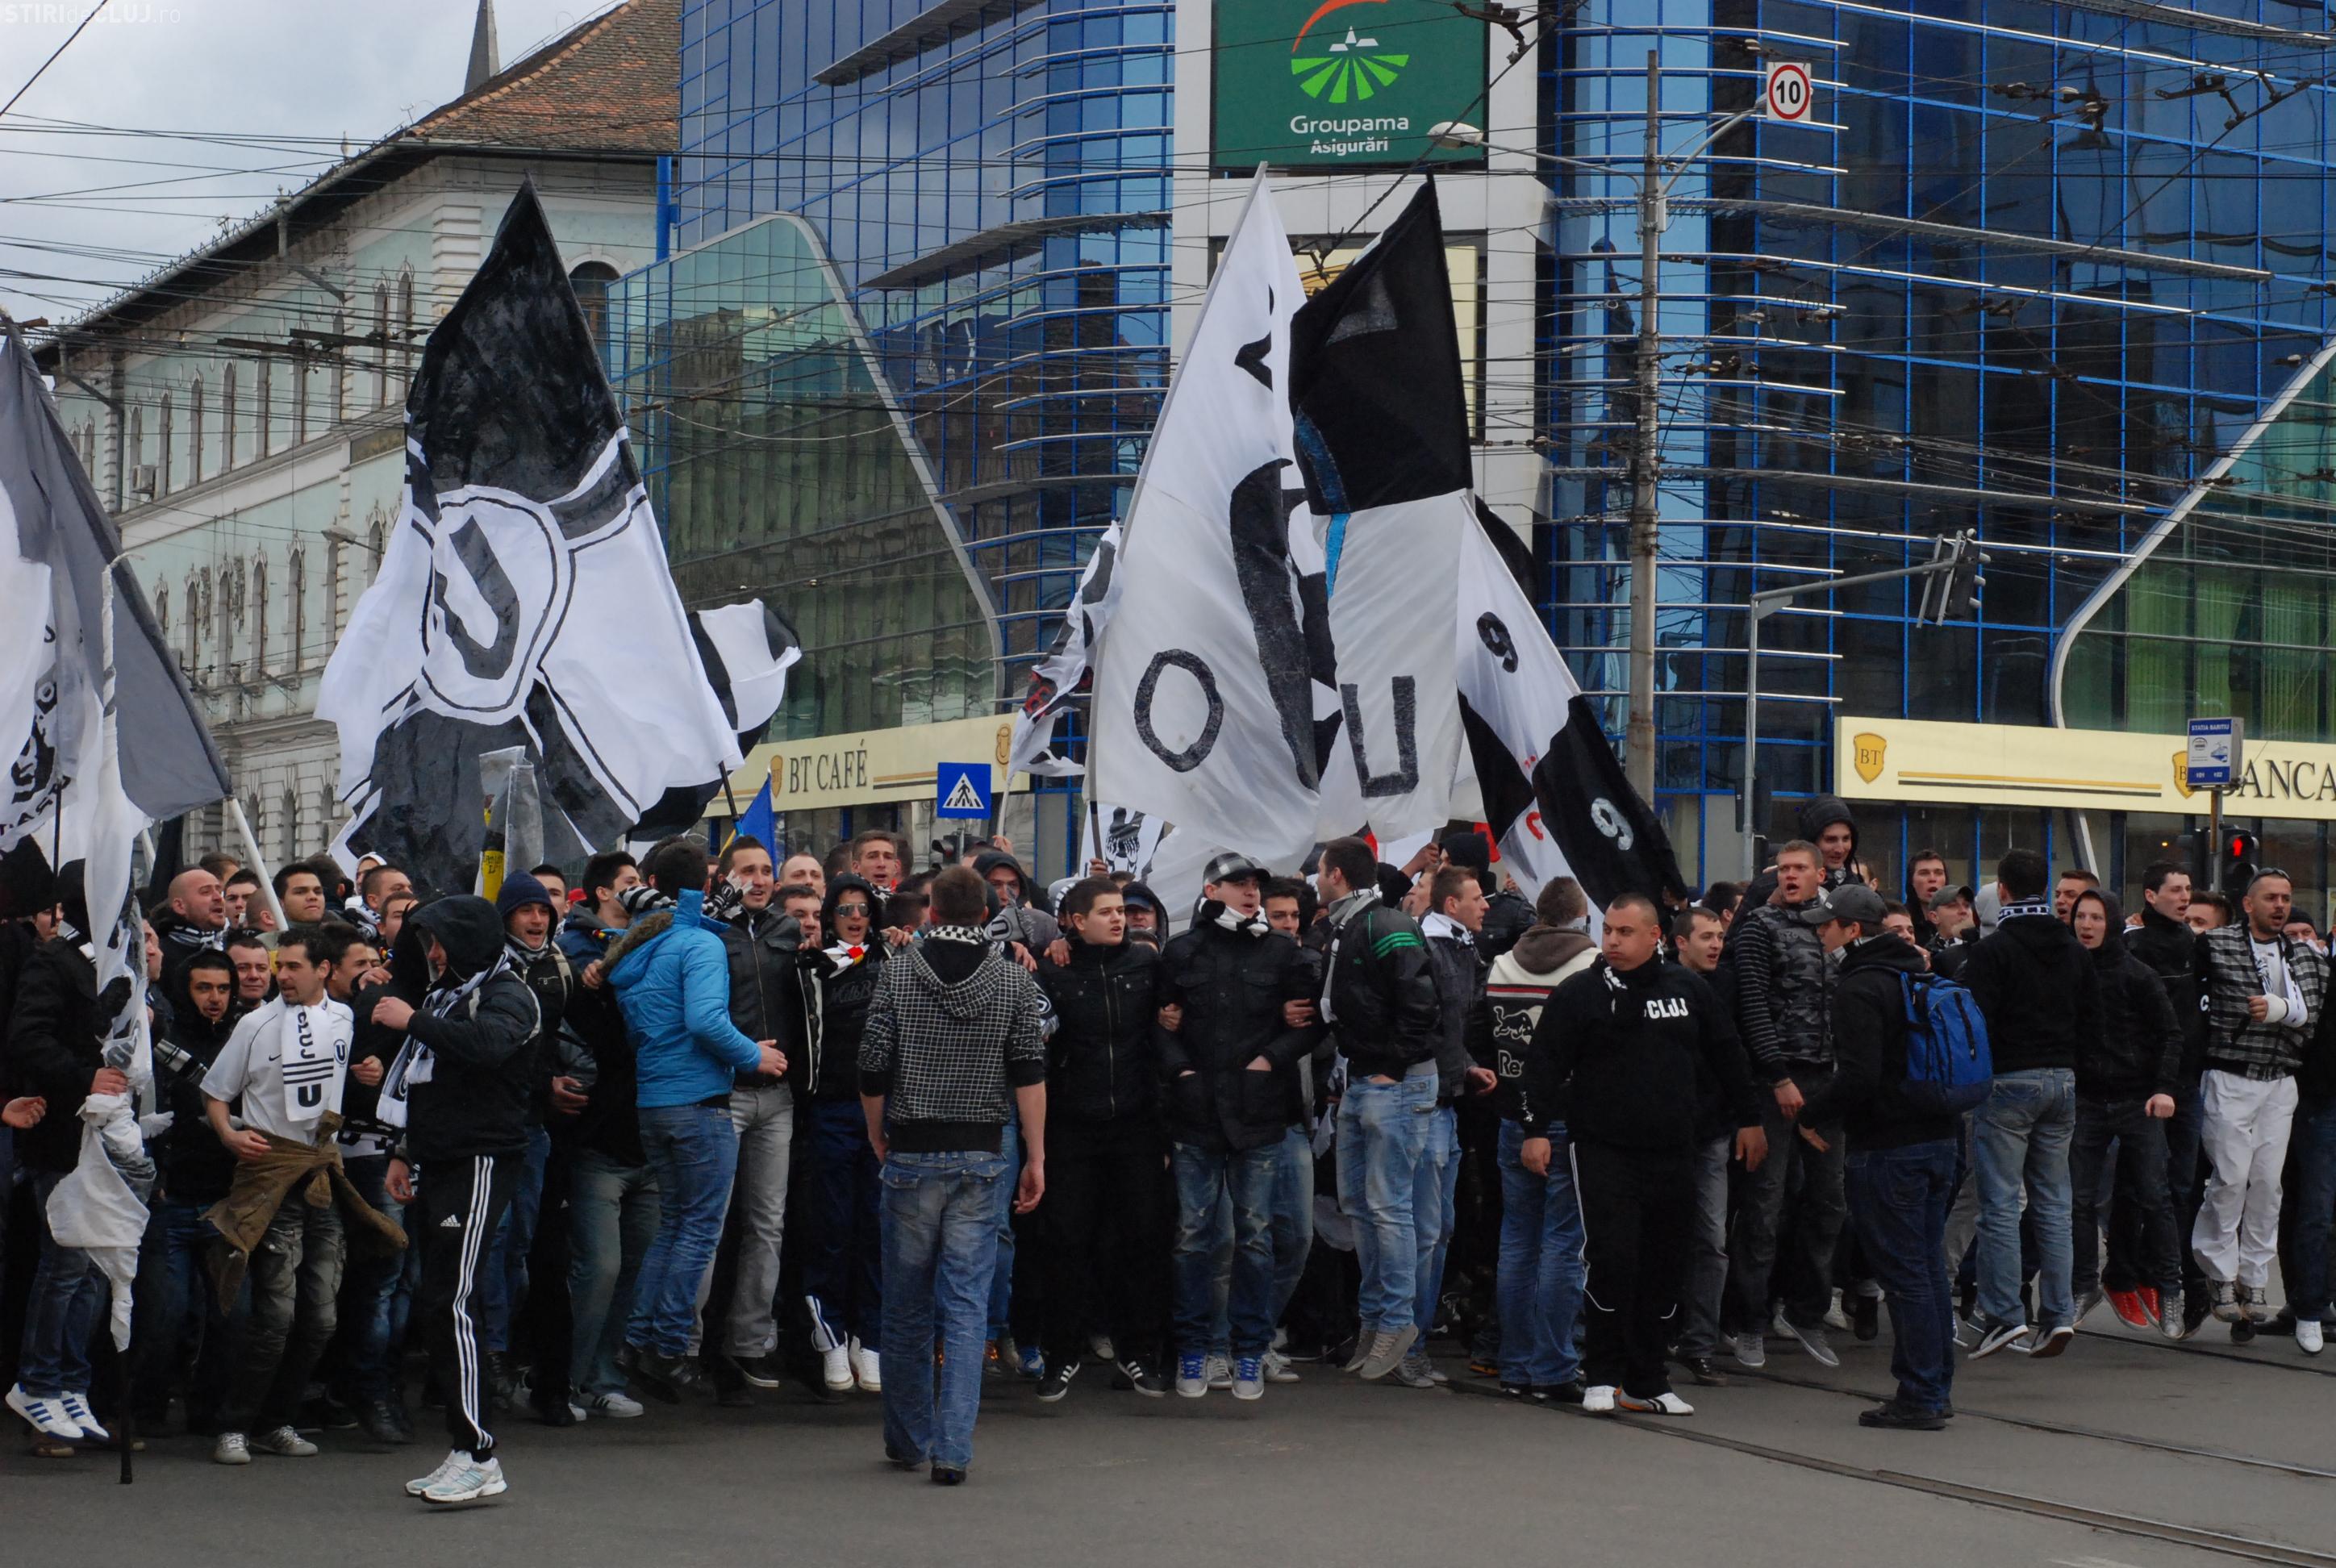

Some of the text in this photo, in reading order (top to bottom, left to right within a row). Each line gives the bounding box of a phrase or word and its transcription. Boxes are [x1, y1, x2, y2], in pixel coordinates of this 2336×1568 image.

[1776, 81, 1800, 104] 10
[1291, 115, 1409, 136] Groupama
[1310, 137, 1388, 156] Asigurări
[1341, 675, 1420, 797] U
[789, 739, 867, 794] BT CAFÉ
[1860, 749, 1881, 765] BT
[2224, 758, 2336, 801] ANCA
[1646, 997, 1688, 1019] CLUJ
[298, 1011, 315, 1059] CLUJ
[1499, 1049, 1524, 1078] Re
[298, 1083, 321, 1107] U
